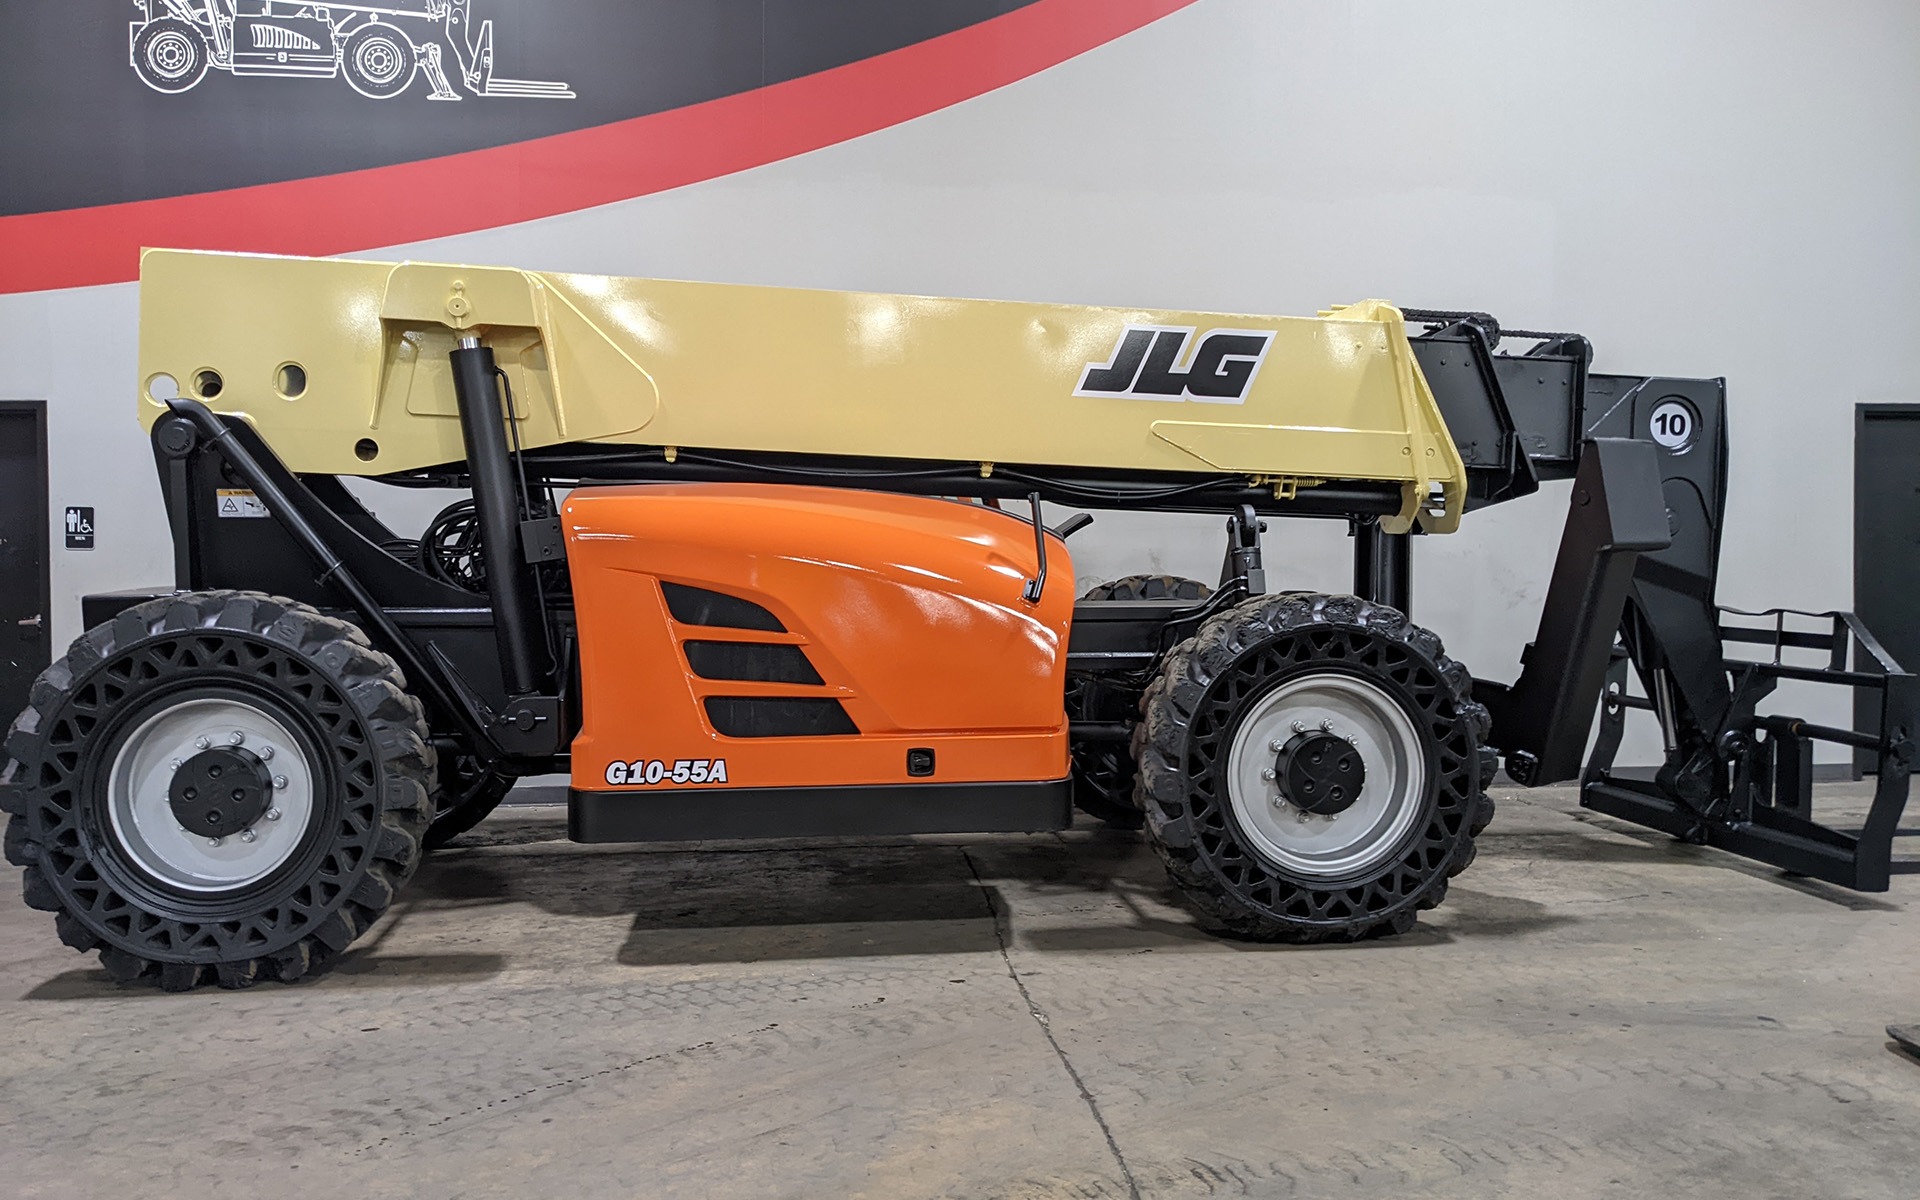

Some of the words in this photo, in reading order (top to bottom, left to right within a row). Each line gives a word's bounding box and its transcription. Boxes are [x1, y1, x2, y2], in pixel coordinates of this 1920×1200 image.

[1080, 328, 1269, 399] JLG
[1654, 413, 1687, 437] 10
[605, 759, 728, 786] G10-55A
